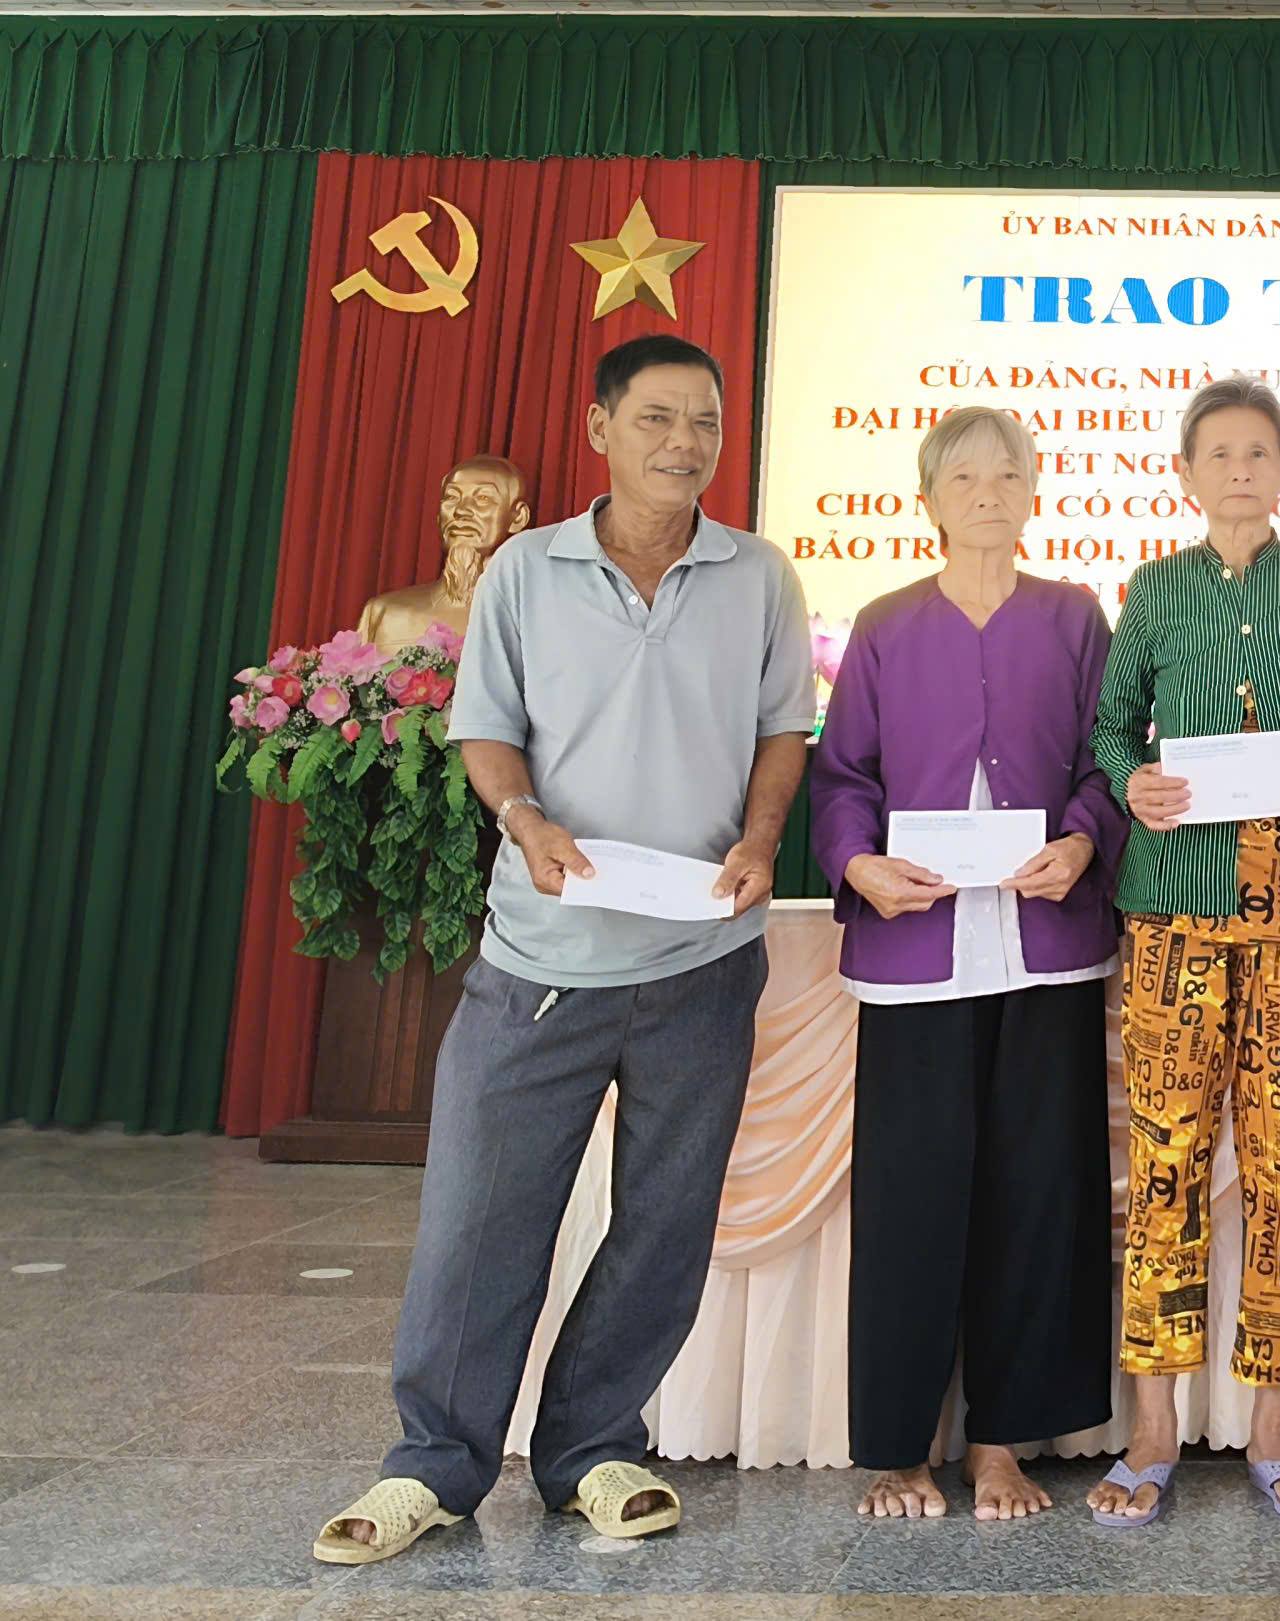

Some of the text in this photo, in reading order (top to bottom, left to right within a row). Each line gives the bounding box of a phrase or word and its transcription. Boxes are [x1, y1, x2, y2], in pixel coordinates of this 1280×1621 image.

[1001, 210, 1046, 236] ỦY
[1053, 215, 1118, 237] BAN
[1127, 212, 1216, 238] NHÂN
[963, 274, 1231, 327] TRAO
[919, 359, 1000, 389] CỦA
[1008, 360, 1128, 393] ĐẢNG,
[831, 405, 902, 433] ĐẠI
[1076, 405, 1164, 433] BIỂU
[1036, 446, 1102, 474] TẾT
[817, 493, 902, 517] CHO
[1056, 488, 1112, 518] CÓ
[1123, 489, 1202, 518] CÔN
[793, 529, 876, 560] BẢO
[1044, 534, 1126, 567] HỘI,
[1164, 940, 1183, 1000] CHANEL
[1162, 1071, 1204, 1091] D&G
